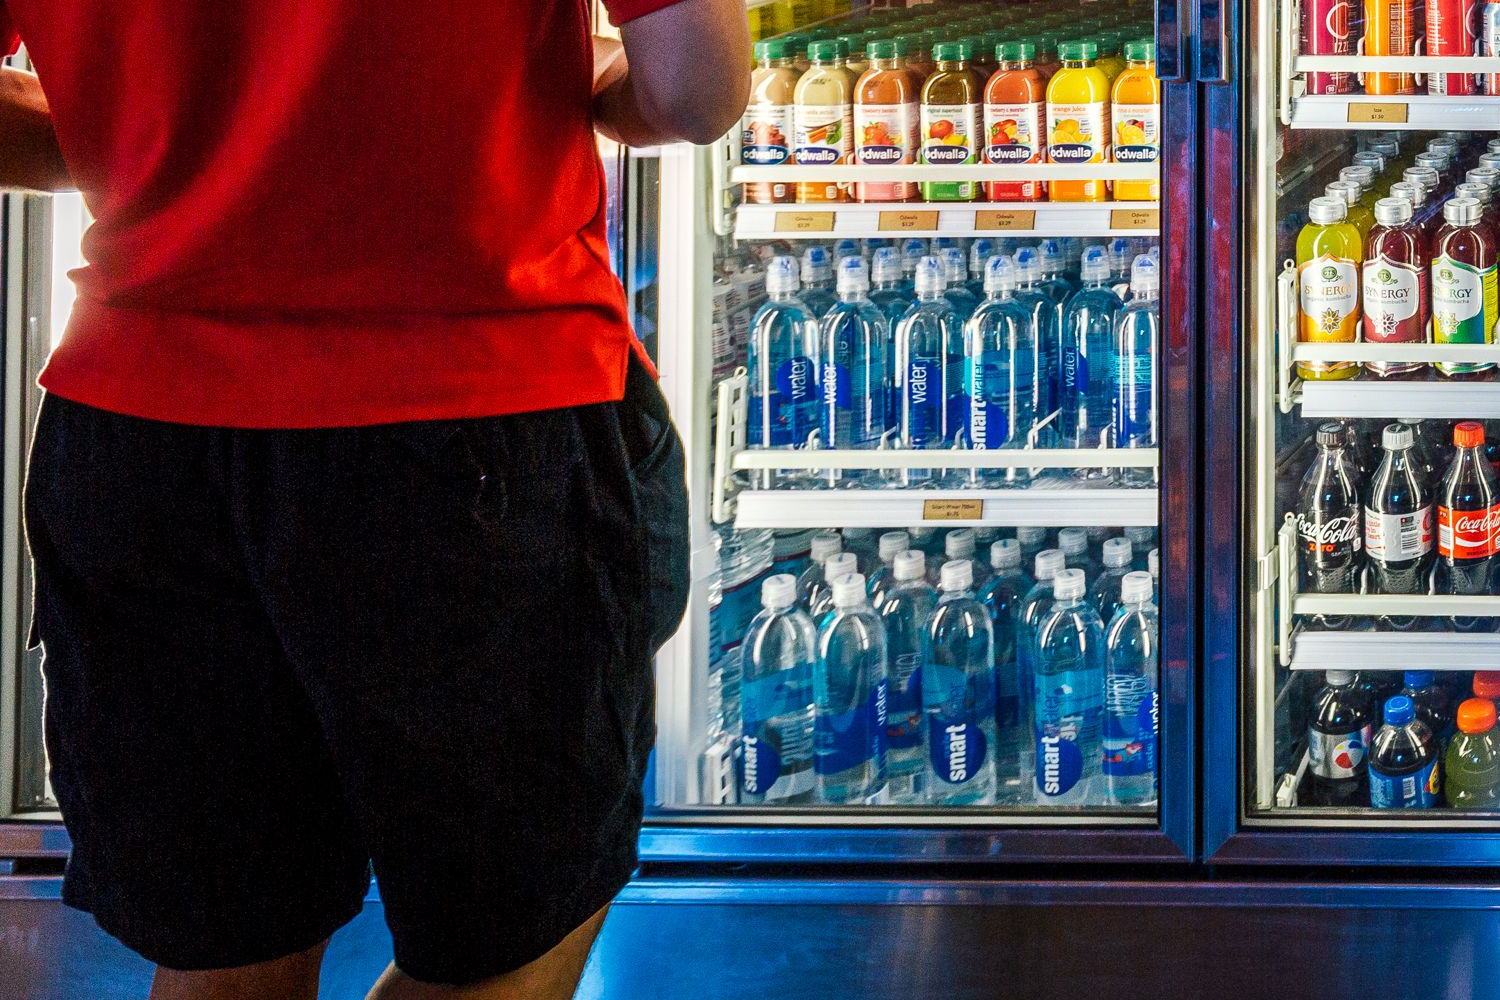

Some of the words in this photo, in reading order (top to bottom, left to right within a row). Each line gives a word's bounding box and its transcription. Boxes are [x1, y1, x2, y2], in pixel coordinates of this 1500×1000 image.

[859, 148, 901, 160] odwalla
[924, 148, 968, 160] odwalla
[988, 149, 1031, 160] odwalla
[1049, 147, 1091, 159] odwalla
[1115, 150, 1155, 160] odwalla
[1365, 286, 1411, 299] SYNERGY
[788, 360, 806, 400] water
[822, 363, 838, 404] water
[909, 363, 928, 404] water
[1066, 349, 1075, 387] water
[971, 401, 987, 450] smart
[876, 683, 888, 725] water
[743, 735, 758, 792] smart
[945, 723, 967, 782] smart
[1041, 735, 1060, 795] smart
